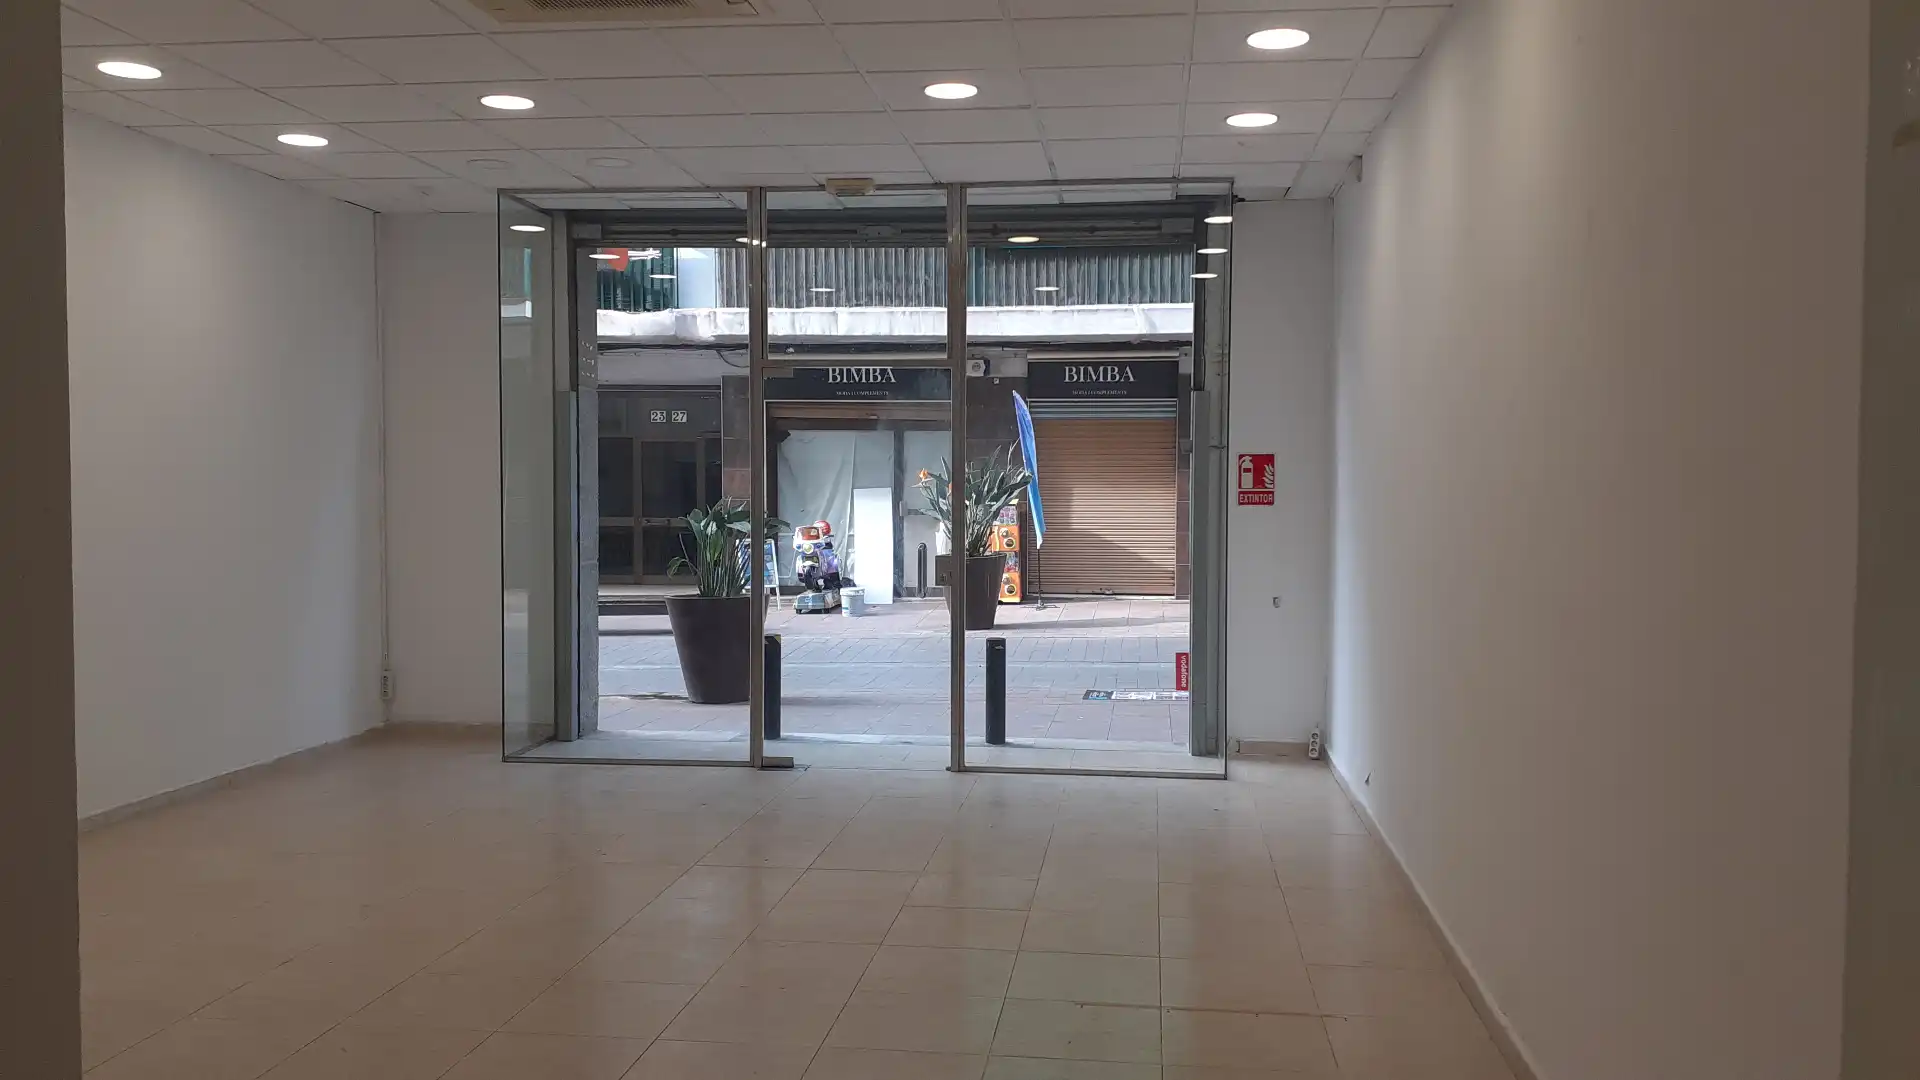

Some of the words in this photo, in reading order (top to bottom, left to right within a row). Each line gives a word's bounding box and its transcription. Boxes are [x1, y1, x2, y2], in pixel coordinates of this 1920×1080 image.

[828, 366, 896, 383] BIMBA
[1064, 365, 1135, 382] BIMBA
[651, 411, 666, 421] 23
[672, 411, 686, 421] 27
[1240, 494, 1273, 503] EXTINTOR
[1180, 655, 1188, 688] vodafone
